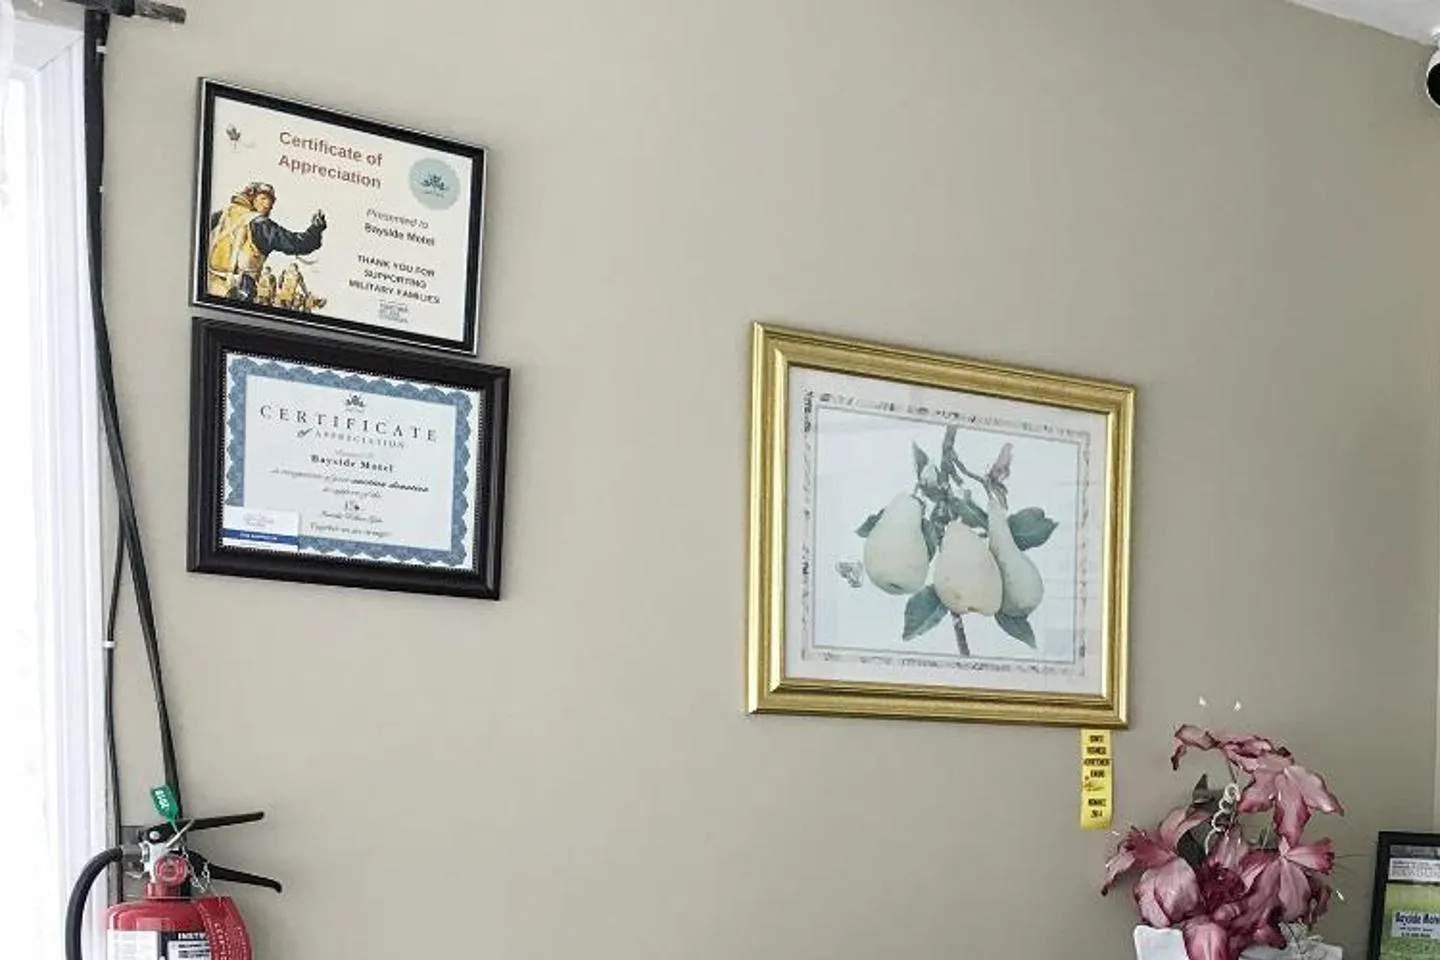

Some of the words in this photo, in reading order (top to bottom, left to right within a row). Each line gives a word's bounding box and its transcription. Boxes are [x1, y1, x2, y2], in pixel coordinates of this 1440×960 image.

[279, 131, 362, 163] Certificate
[366, 152, 384, 168] of
[278, 154, 381, 189] Appreciation
[364, 222, 404, 240] Bayside
[407, 232, 435, 246] Motel
[358, 254, 391, 269] THANK
[393, 262, 414, 273] YOU
[415, 266, 435, 277] FOR
[364, 269, 427, 289] SUPPORTING
[348, 279, 394, 295] MILITARY
[396, 288, 441, 304] FAMILIES
[260, 405, 437, 442] CERTIFICATE
[311, 454, 355, 469] Bayside
[360, 462, 394, 473] Motel
